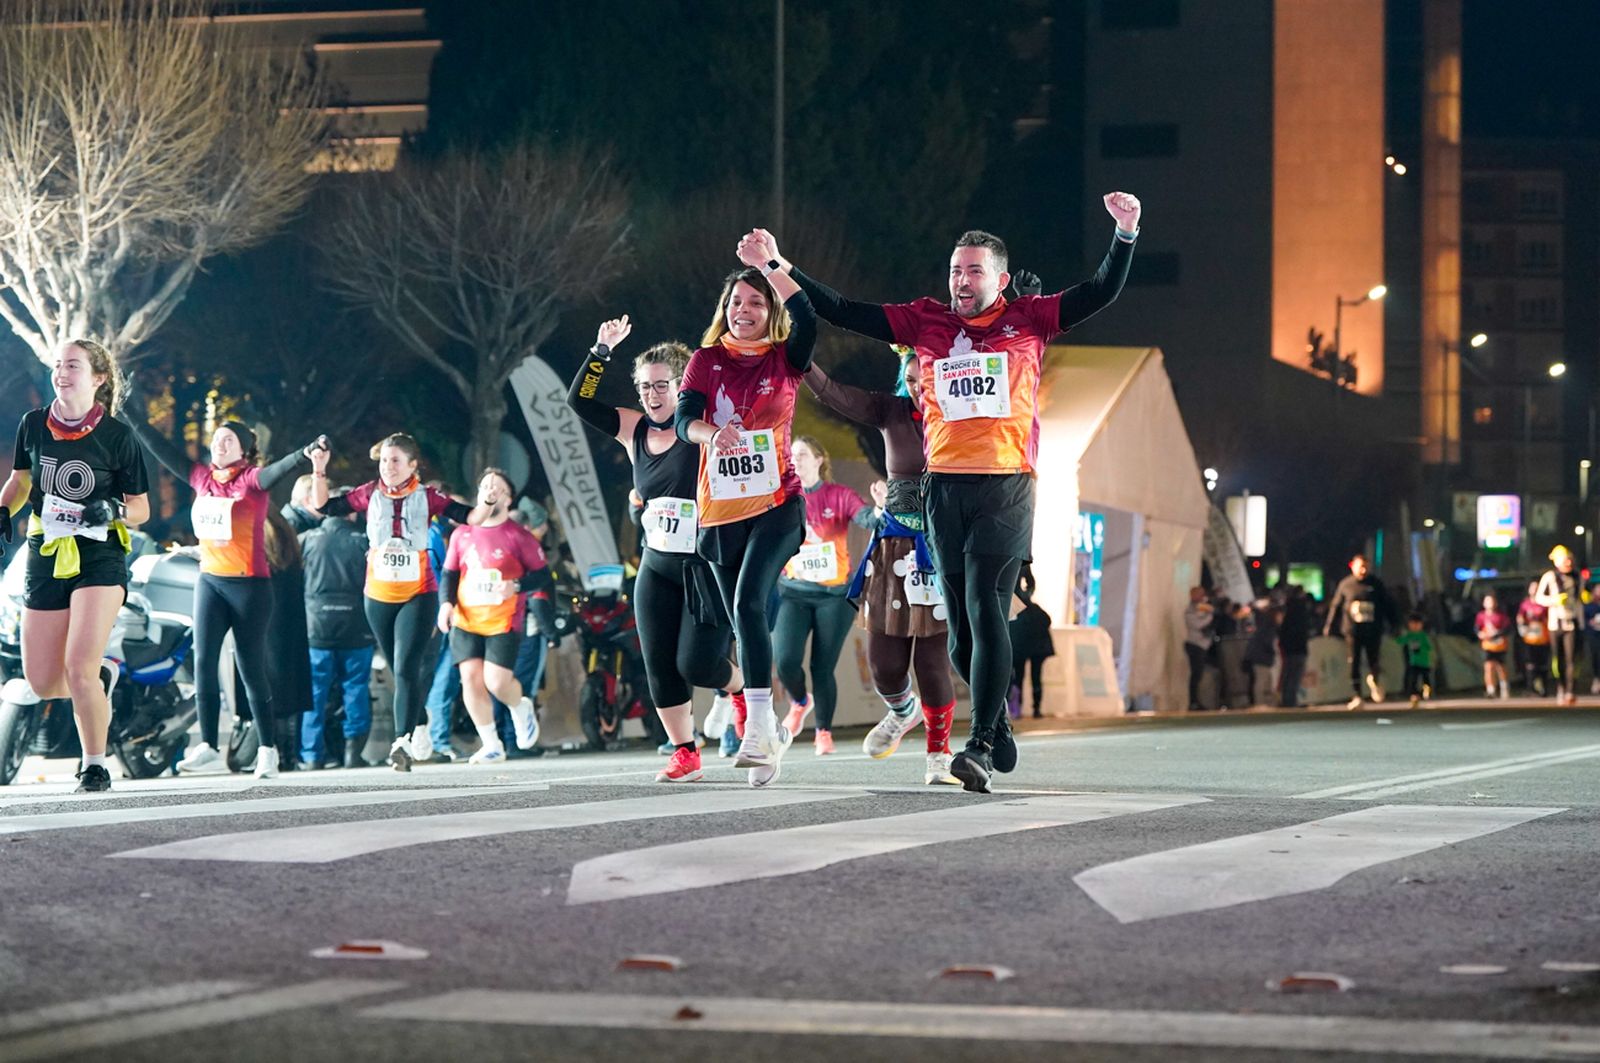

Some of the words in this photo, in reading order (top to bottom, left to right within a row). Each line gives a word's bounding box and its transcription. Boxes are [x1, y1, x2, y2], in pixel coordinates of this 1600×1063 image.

[972, 360, 981, 368] DE
[943, 371, 956, 381] SAN
[957, 367, 982, 378] ANTON
[948, 376, 996, 398] 4082
[546, 388, 605, 523] JAPEMASA
[724, 447, 749, 456] ANTON
[718, 453, 765, 477] 4083
[39, 455, 95, 501] 10
[383, 553, 411, 567] 5991
[802, 557, 828, 570] 1903
[911, 570, 935, 586] 30
